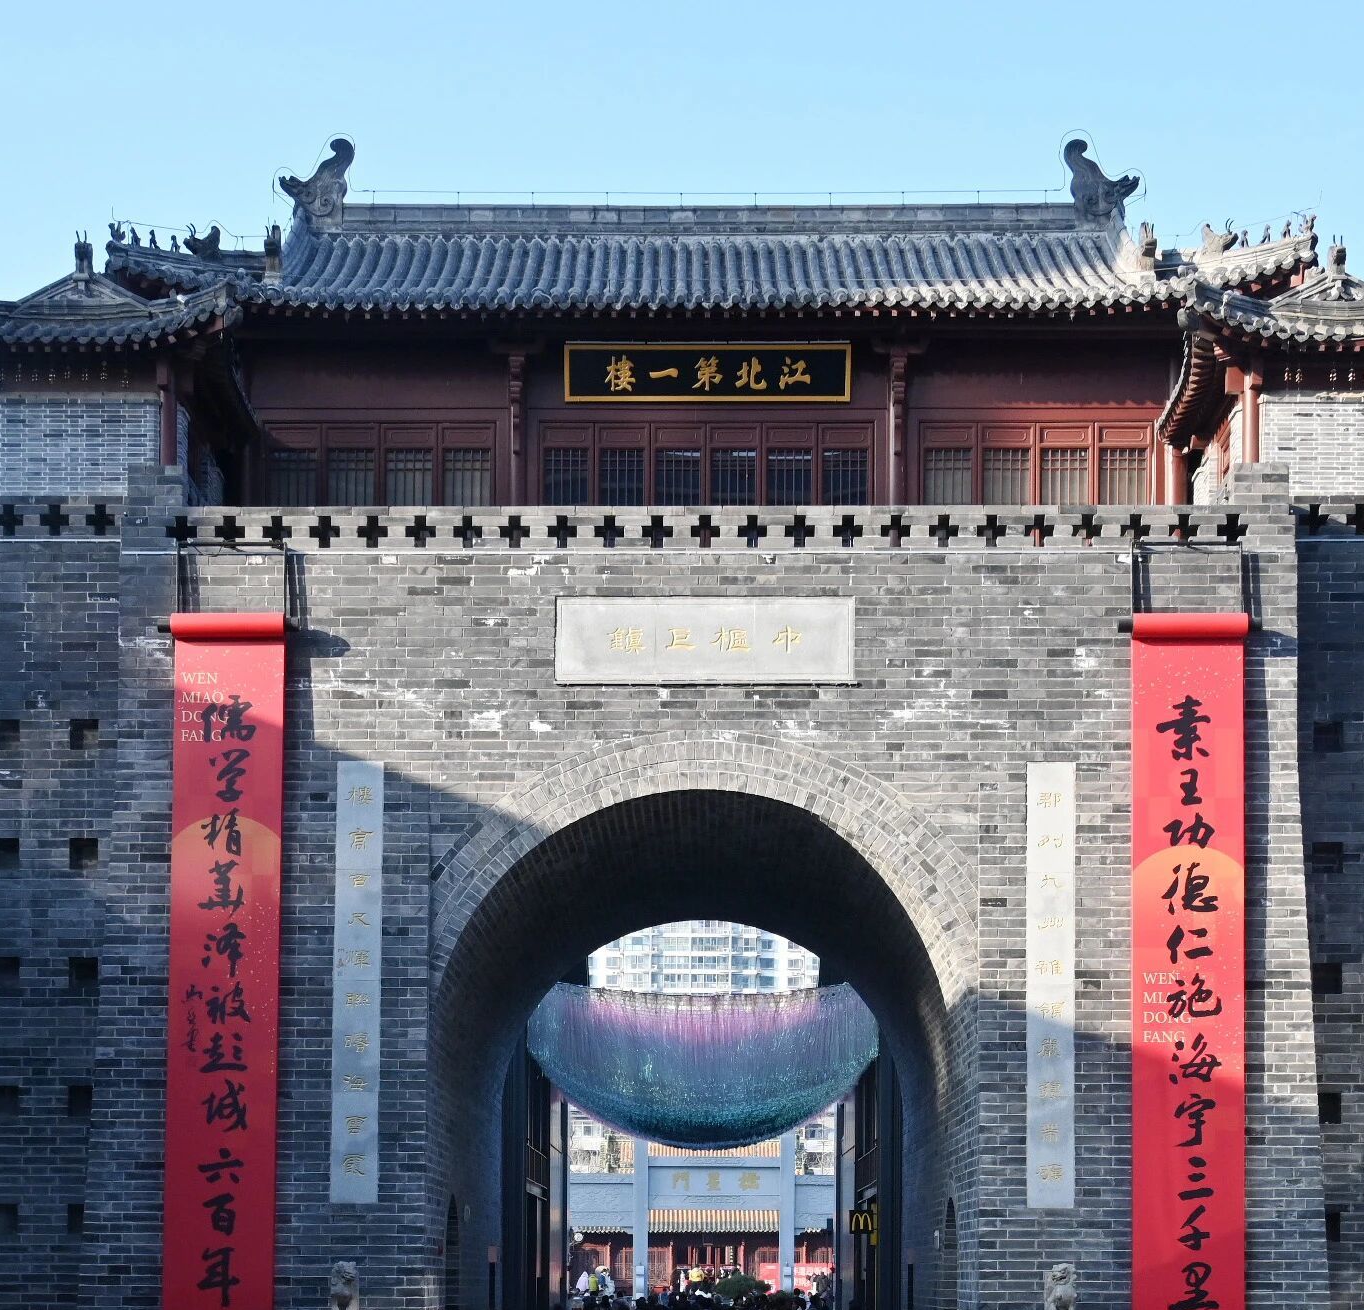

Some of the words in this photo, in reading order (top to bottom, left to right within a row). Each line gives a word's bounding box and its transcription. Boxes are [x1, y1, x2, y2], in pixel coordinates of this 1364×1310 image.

[181, 672, 218, 684] WEN
[182, 691, 224, 704] MIAO
[1143, 972, 1180, 985] WEN
[1143, 1031, 1185, 1043] FANG
